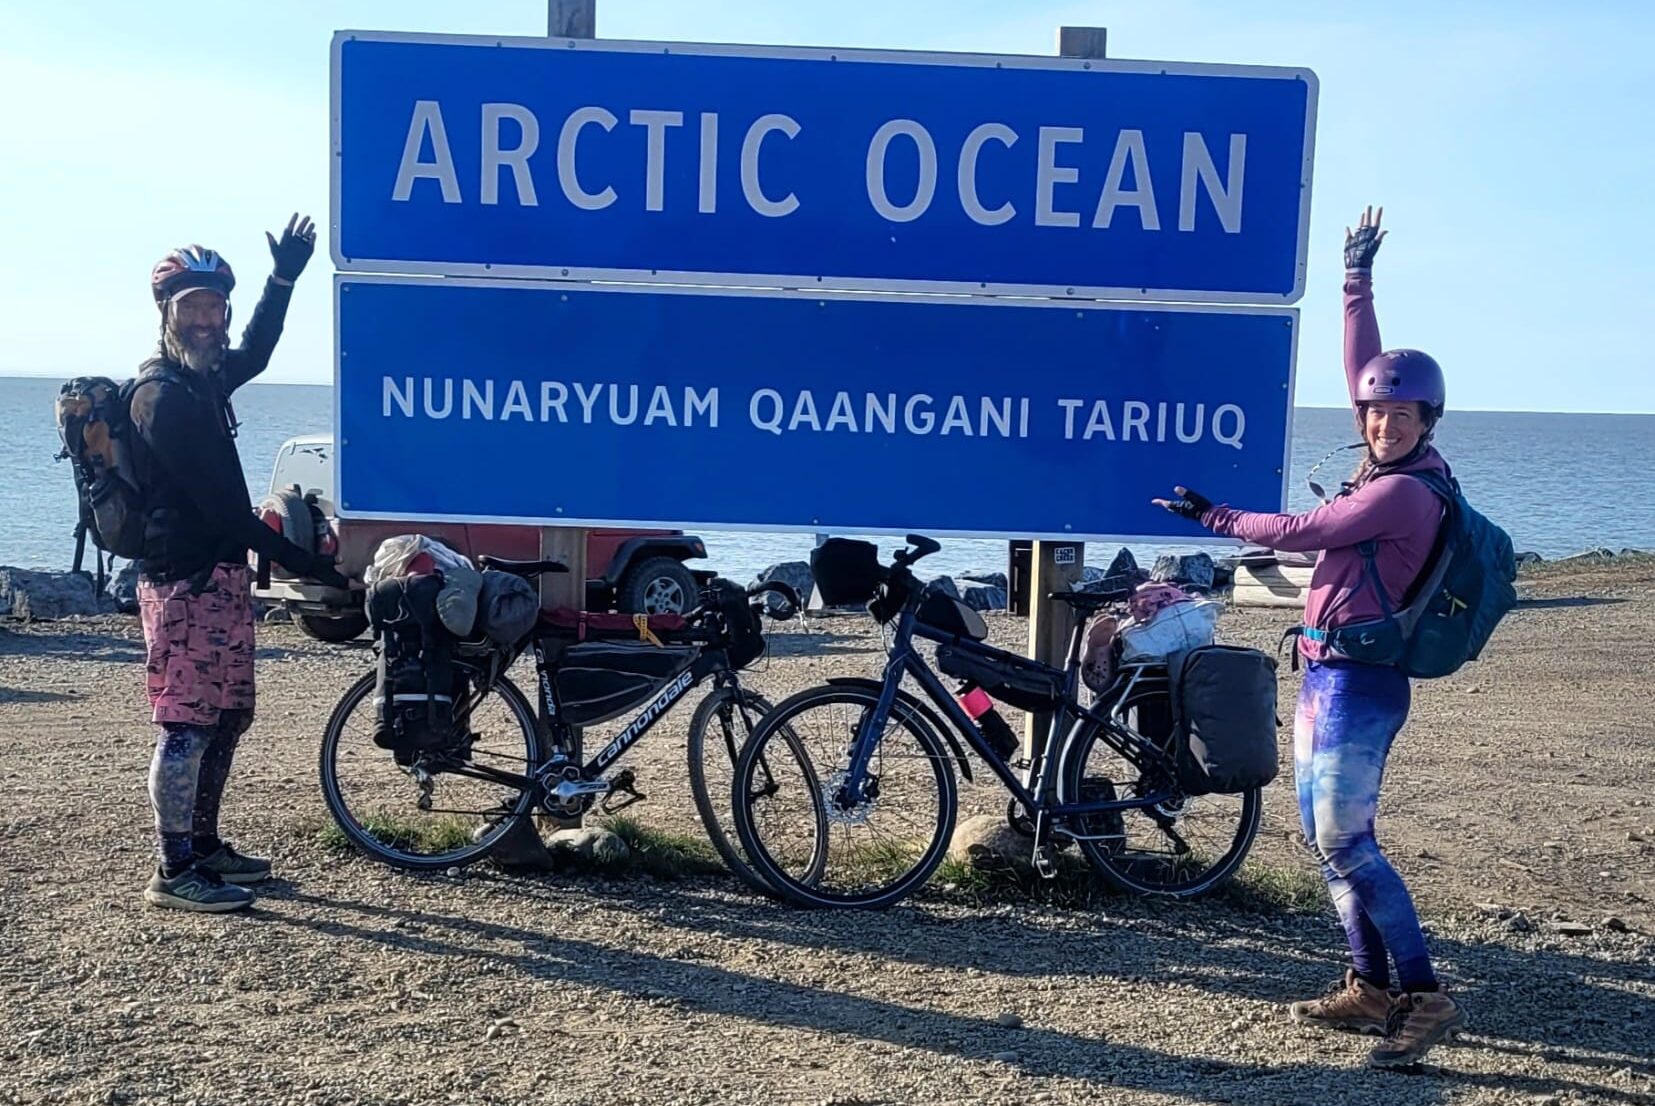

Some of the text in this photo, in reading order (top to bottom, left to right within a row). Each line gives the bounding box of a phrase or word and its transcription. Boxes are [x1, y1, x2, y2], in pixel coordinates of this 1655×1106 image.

[391, 99, 1248, 235] ARCTIC OCEAN
[381, 375, 1247, 450] NUNARYUAM QAANGANI TARIUQ
[596, 671, 694, 767] cannondale
